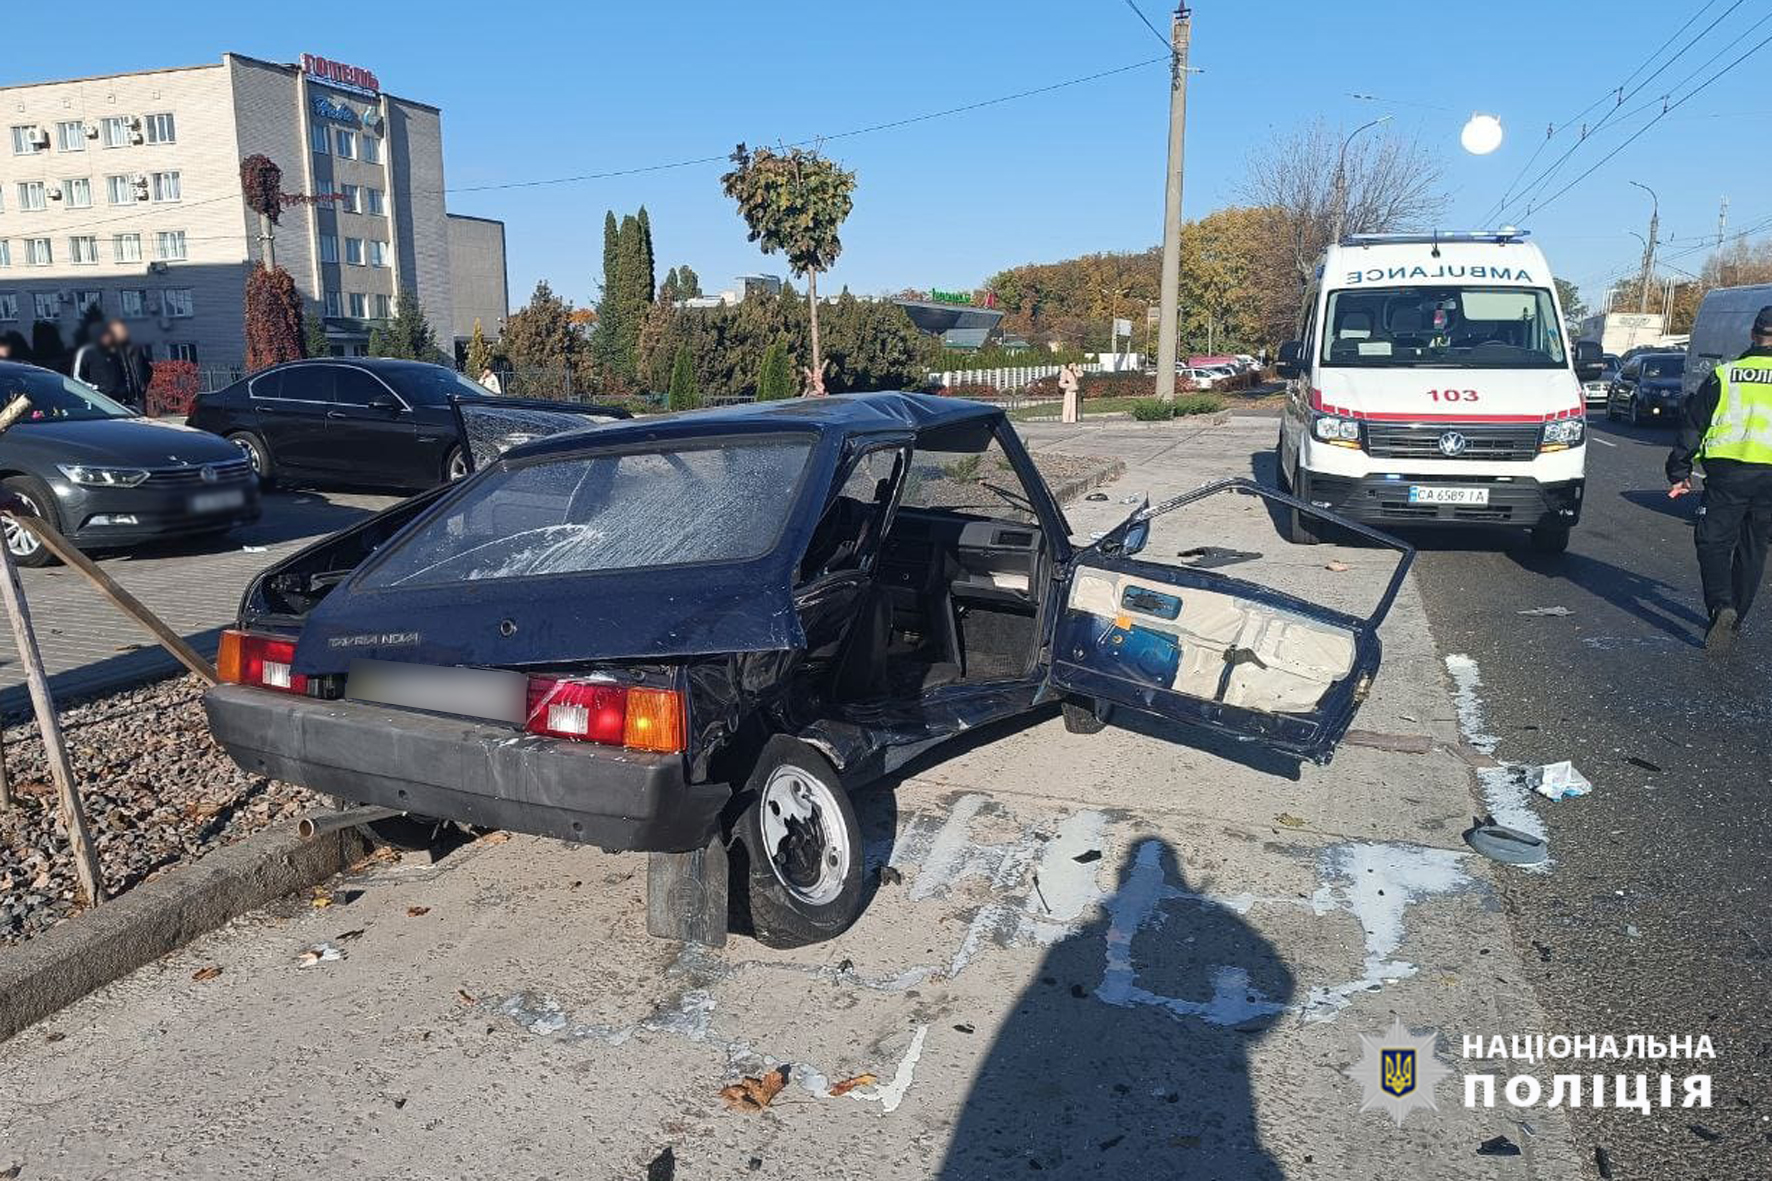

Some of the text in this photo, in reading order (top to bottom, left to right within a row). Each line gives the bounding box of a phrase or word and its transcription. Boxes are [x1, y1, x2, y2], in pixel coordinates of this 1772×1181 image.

[300, 52, 379, 91] ГОТЕЛЬ
[1423, 389, 1479, 402] 103
[1418, 490, 1484, 502] CA 6589 IA
[381, 632, 420, 645] NOVA
